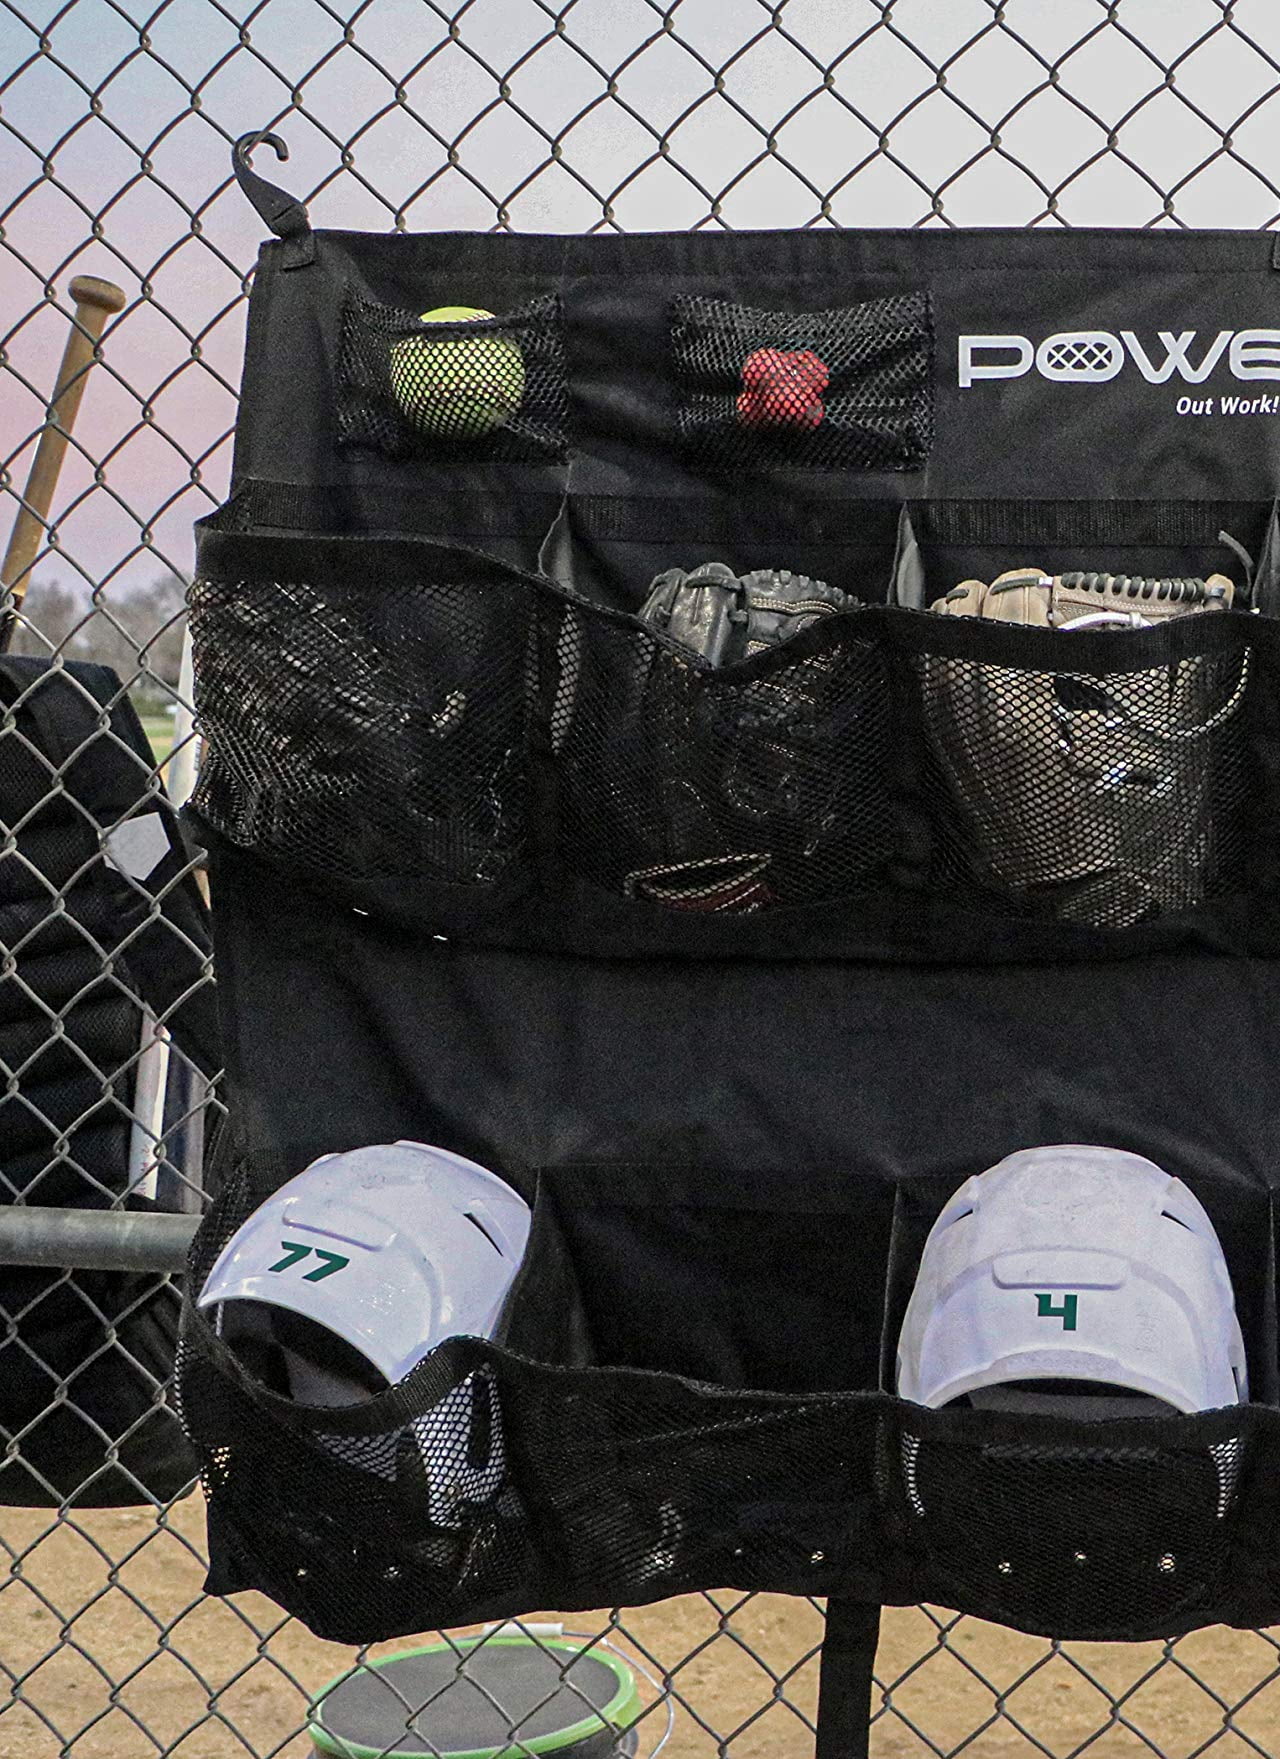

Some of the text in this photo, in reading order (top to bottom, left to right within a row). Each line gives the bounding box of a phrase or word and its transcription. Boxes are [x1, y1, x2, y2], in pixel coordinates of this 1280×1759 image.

[1176, 395, 1214, 416] Out
[1220, 393, 1280, 416] Work!
[269, 1241, 350, 1282] 77
[1034, 1294, 1078, 1331] 4
